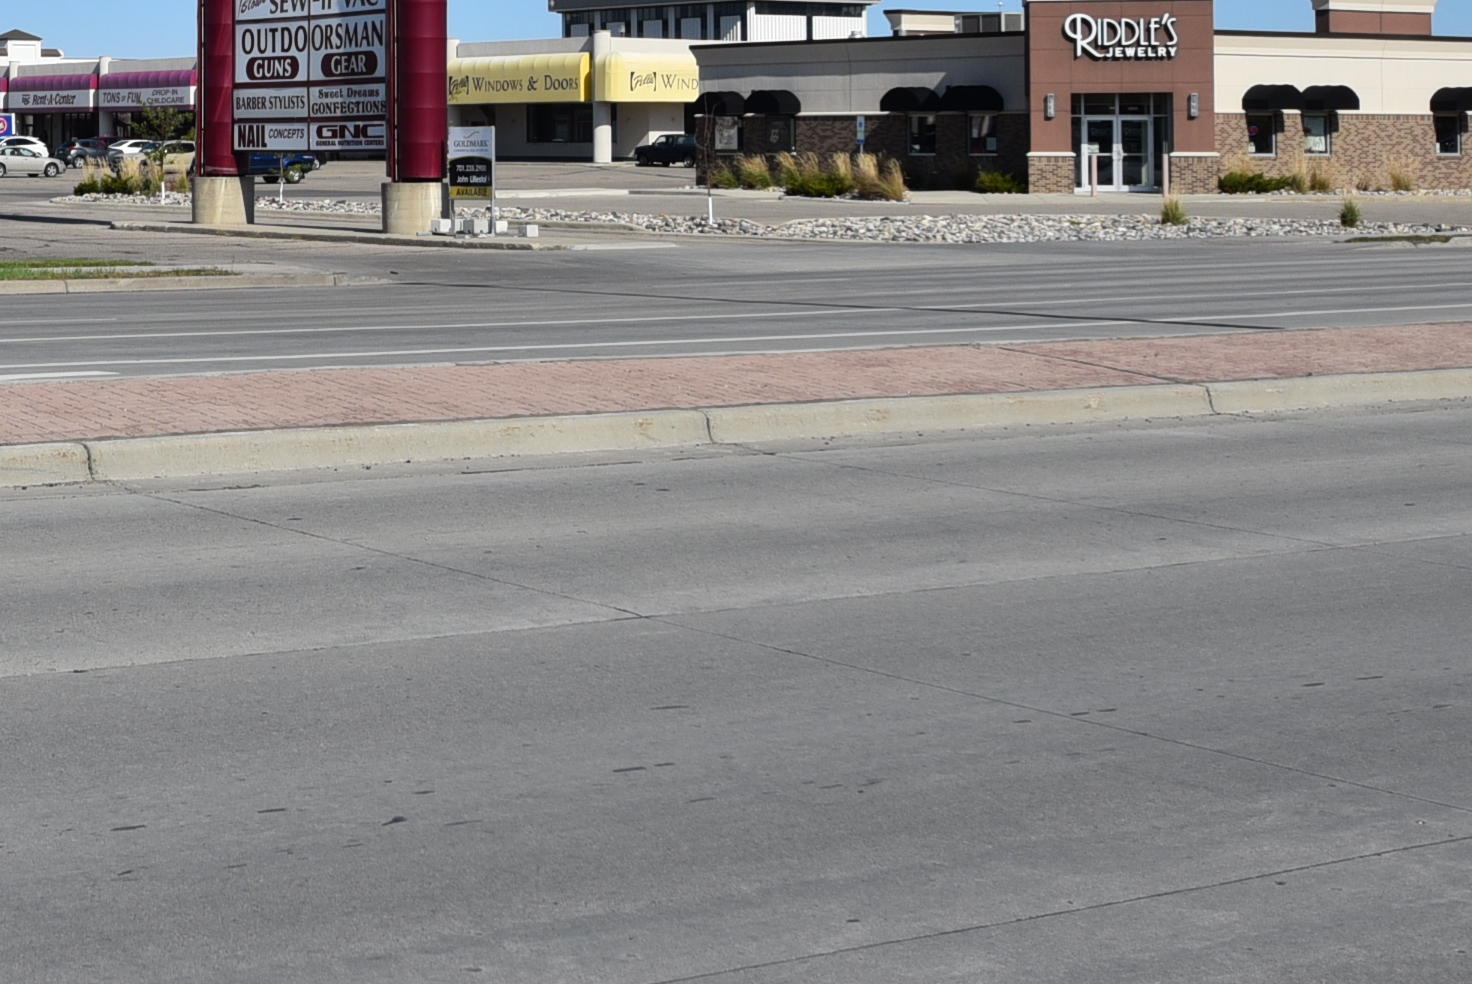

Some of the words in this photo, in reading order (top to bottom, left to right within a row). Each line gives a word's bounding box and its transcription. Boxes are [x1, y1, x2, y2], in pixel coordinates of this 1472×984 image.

[1105, 46, 1178, 57] JEWELRY
[253, 59, 292, 78] GUNS
[331, 54, 367, 74] GEAR
[527, 76, 538, 91] &
[102, 92, 121, 104] TONS
[236, 96, 267, 110] BARBER
[268, 95, 305, 109] STYLISTS
[238, 125, 267, 148] NAIL
[268, 128, 304, 139] CONCEPTS
[316, 123, 385, 139] GNC
